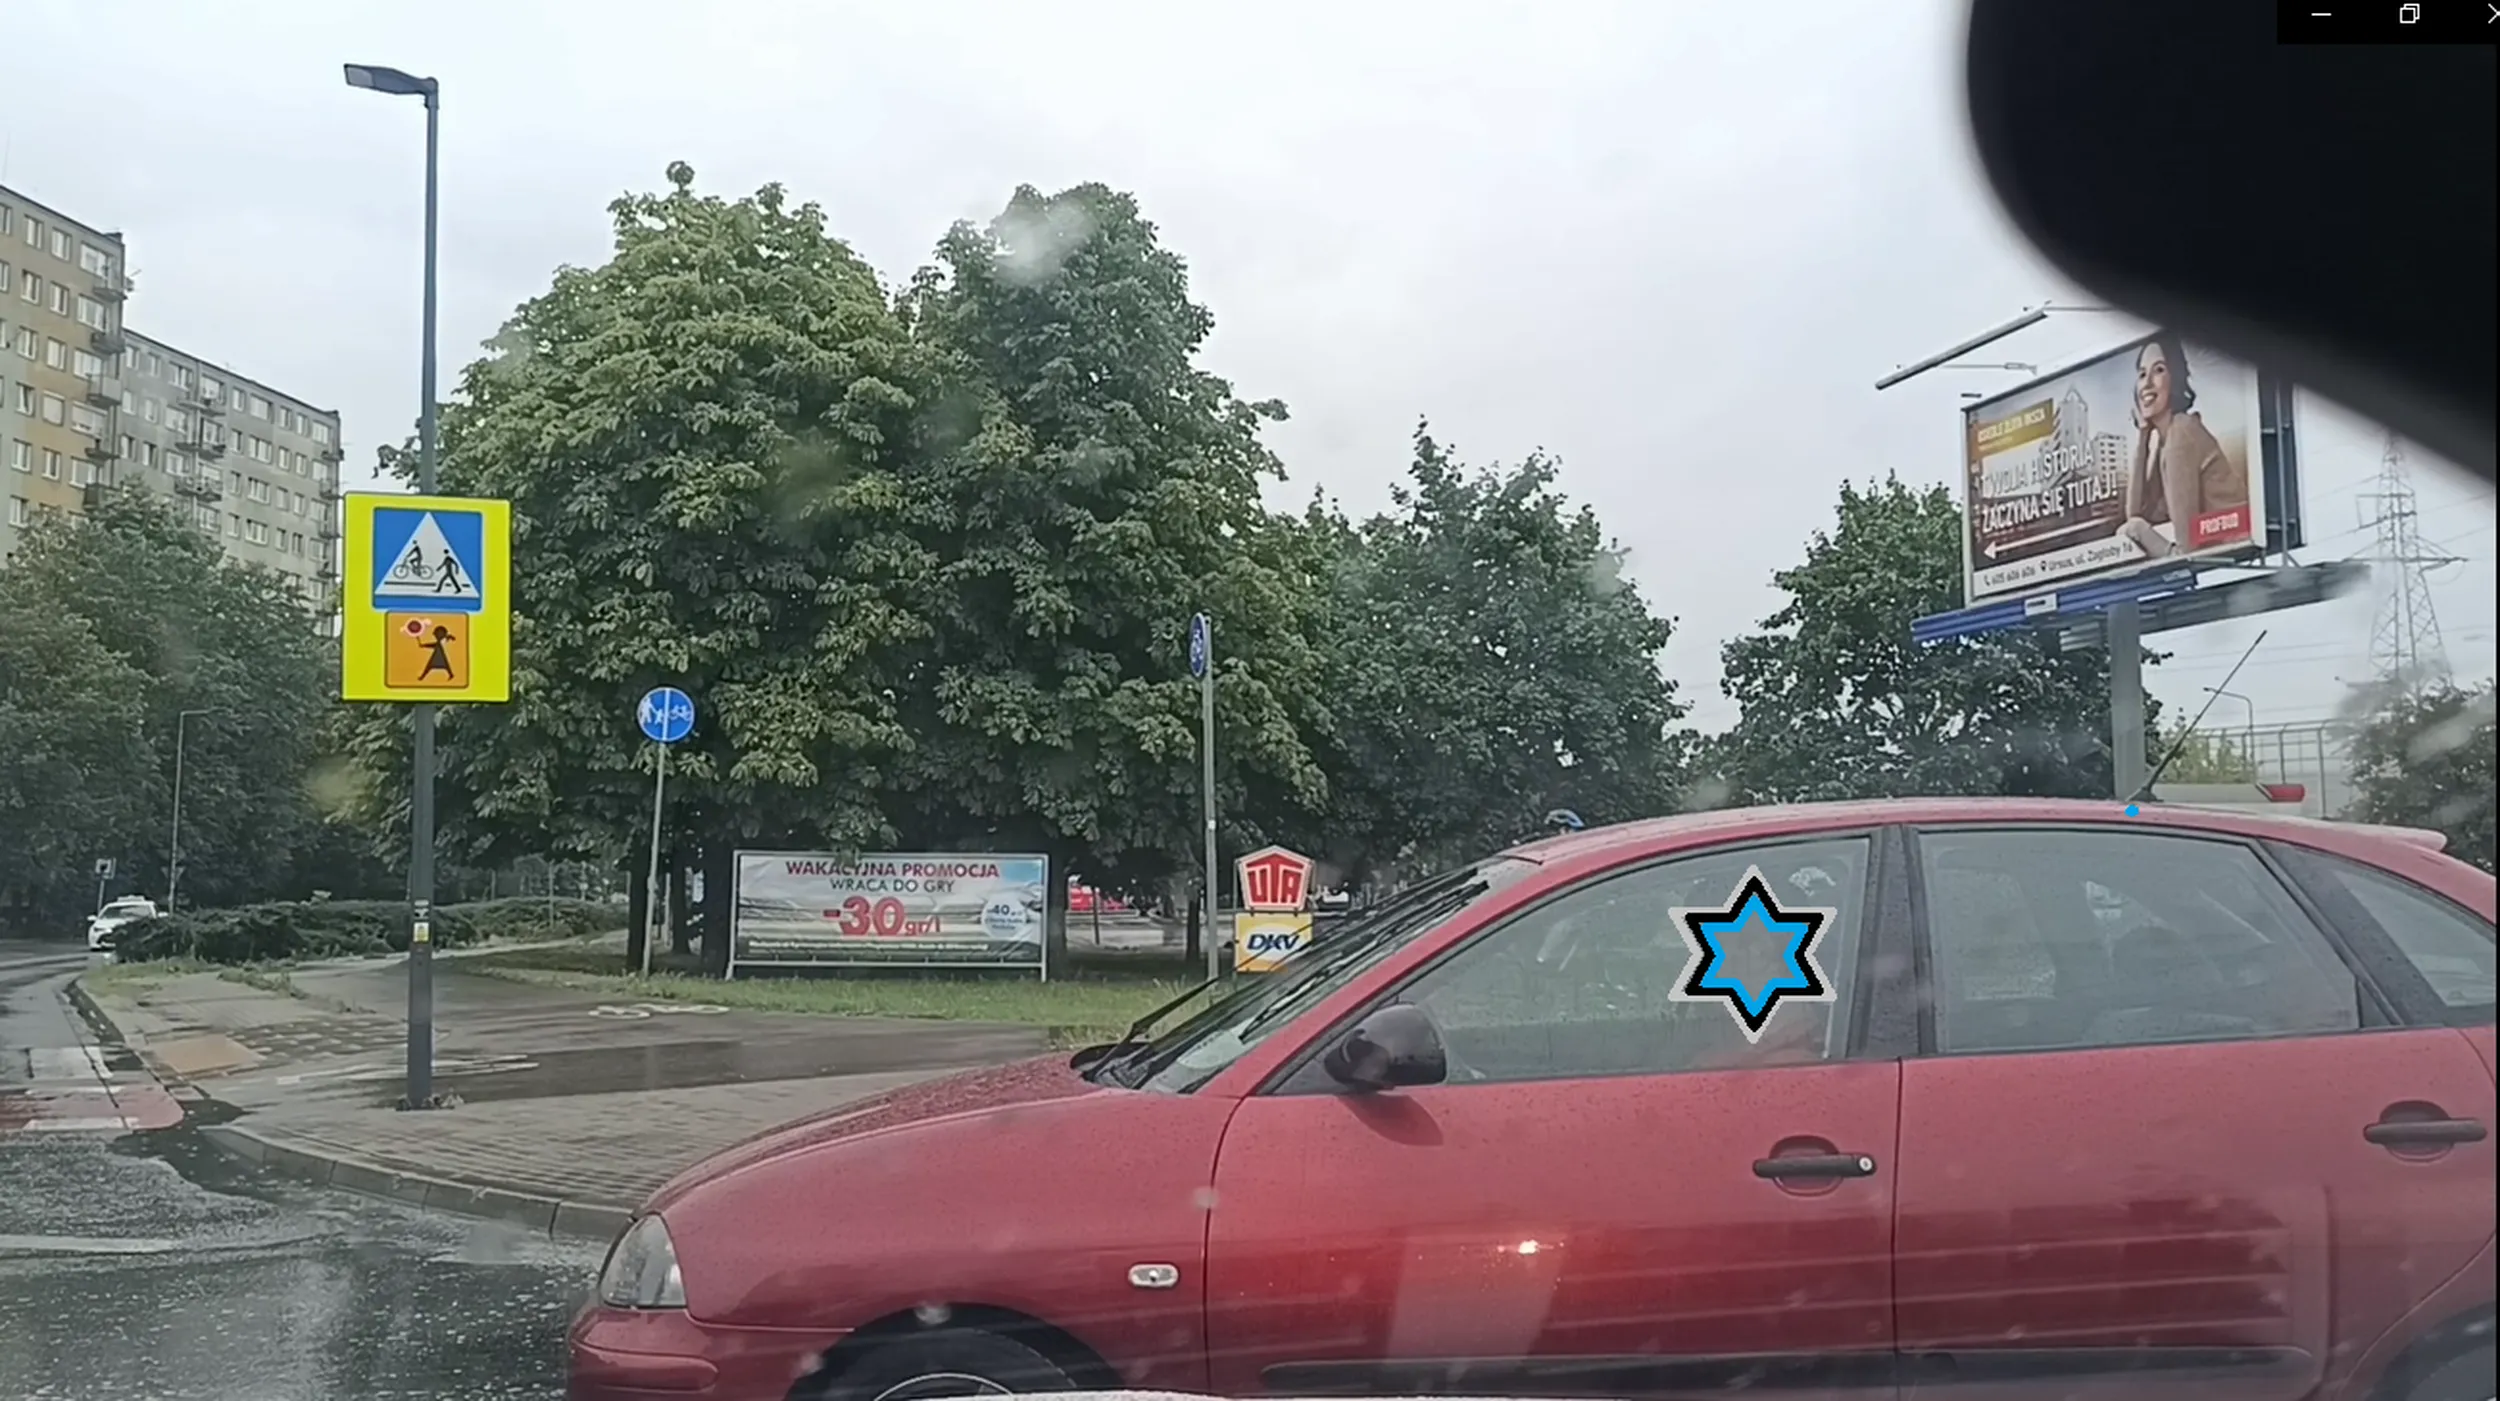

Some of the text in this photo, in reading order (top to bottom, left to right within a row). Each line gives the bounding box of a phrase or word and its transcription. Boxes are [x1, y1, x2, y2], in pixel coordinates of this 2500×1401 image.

[1981, 493, 2040, 534] ZACZYNA
[2041, 485, 2065, 518] SIĘ
[2065, 471, 2118, 509] TUTAJ!
[2199, 512, 2240, 536] PROFBUD
[785, 861, 999, 879] WAKACYJNA PROMOCJA
[1244, 852, 1305, 904] UTA
[830, 877, 956, 894] WRACA DO GRY
[1246, 933, 1300, 950] DKV
